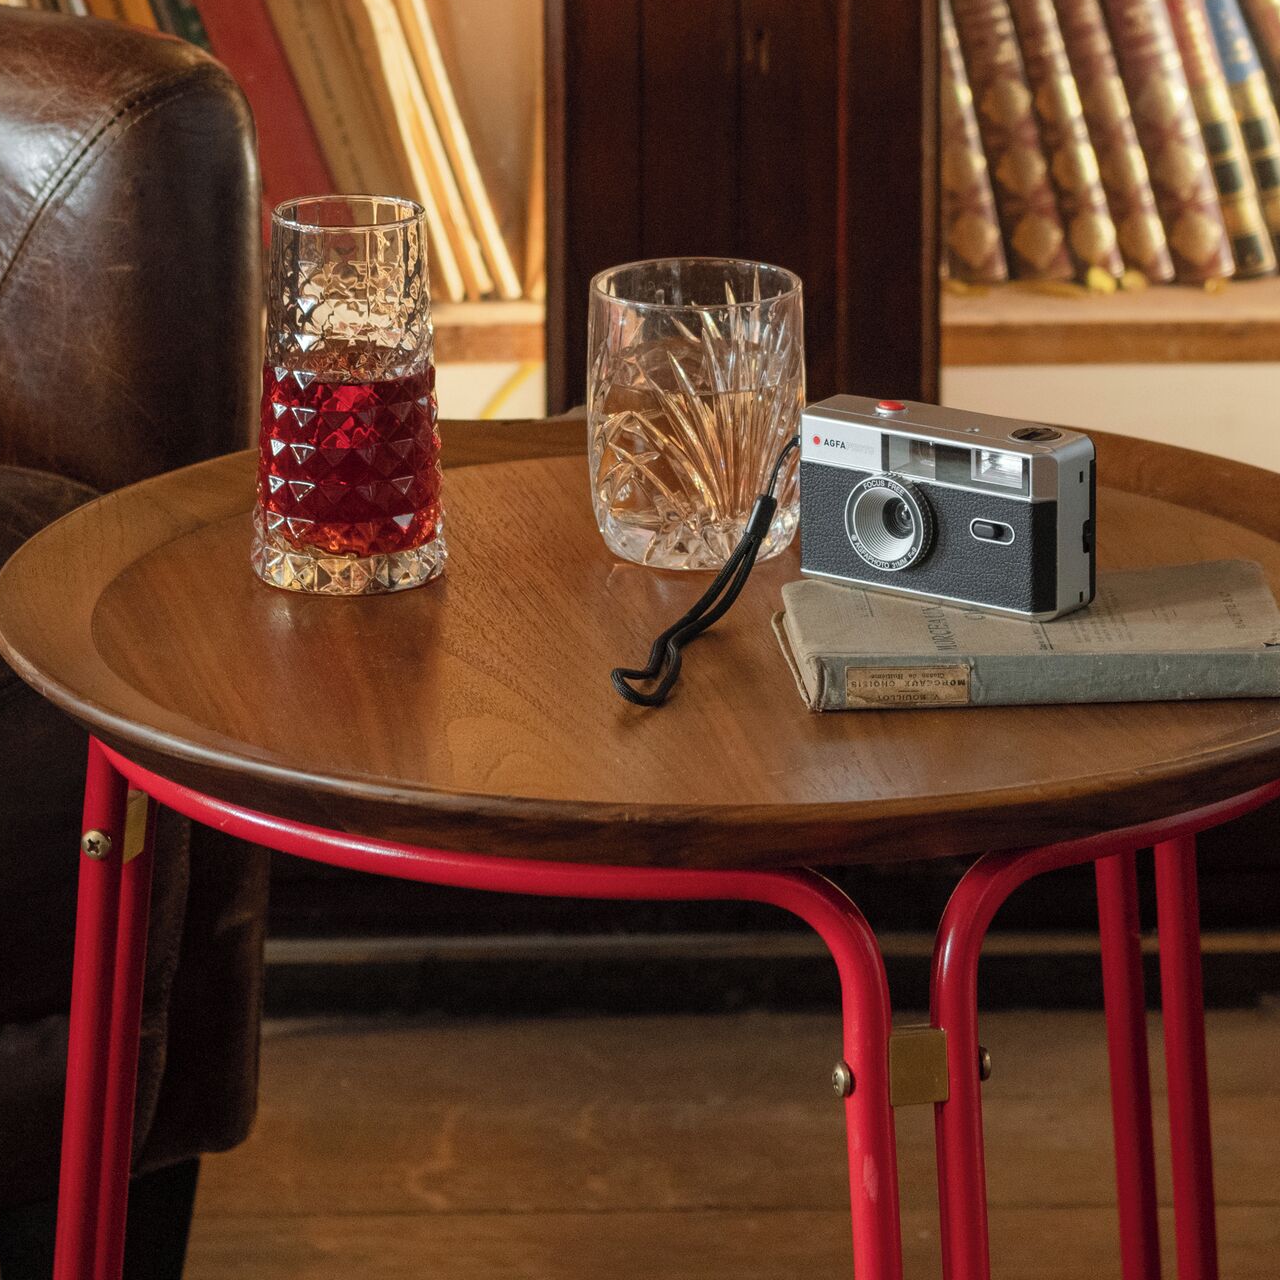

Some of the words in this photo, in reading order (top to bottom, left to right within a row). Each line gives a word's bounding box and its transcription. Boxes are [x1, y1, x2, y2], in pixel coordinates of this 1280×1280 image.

[823, 438, 846, 449] AGFA
[863, 480, 885, 490] FOCUS
[887, 482, 905, 496] FREE
[854, 542, 890, 569] AGFAPHOTO
[891, 558, 908, 569] 31MM
[904, 679, 966, 688] MORCEAUX
